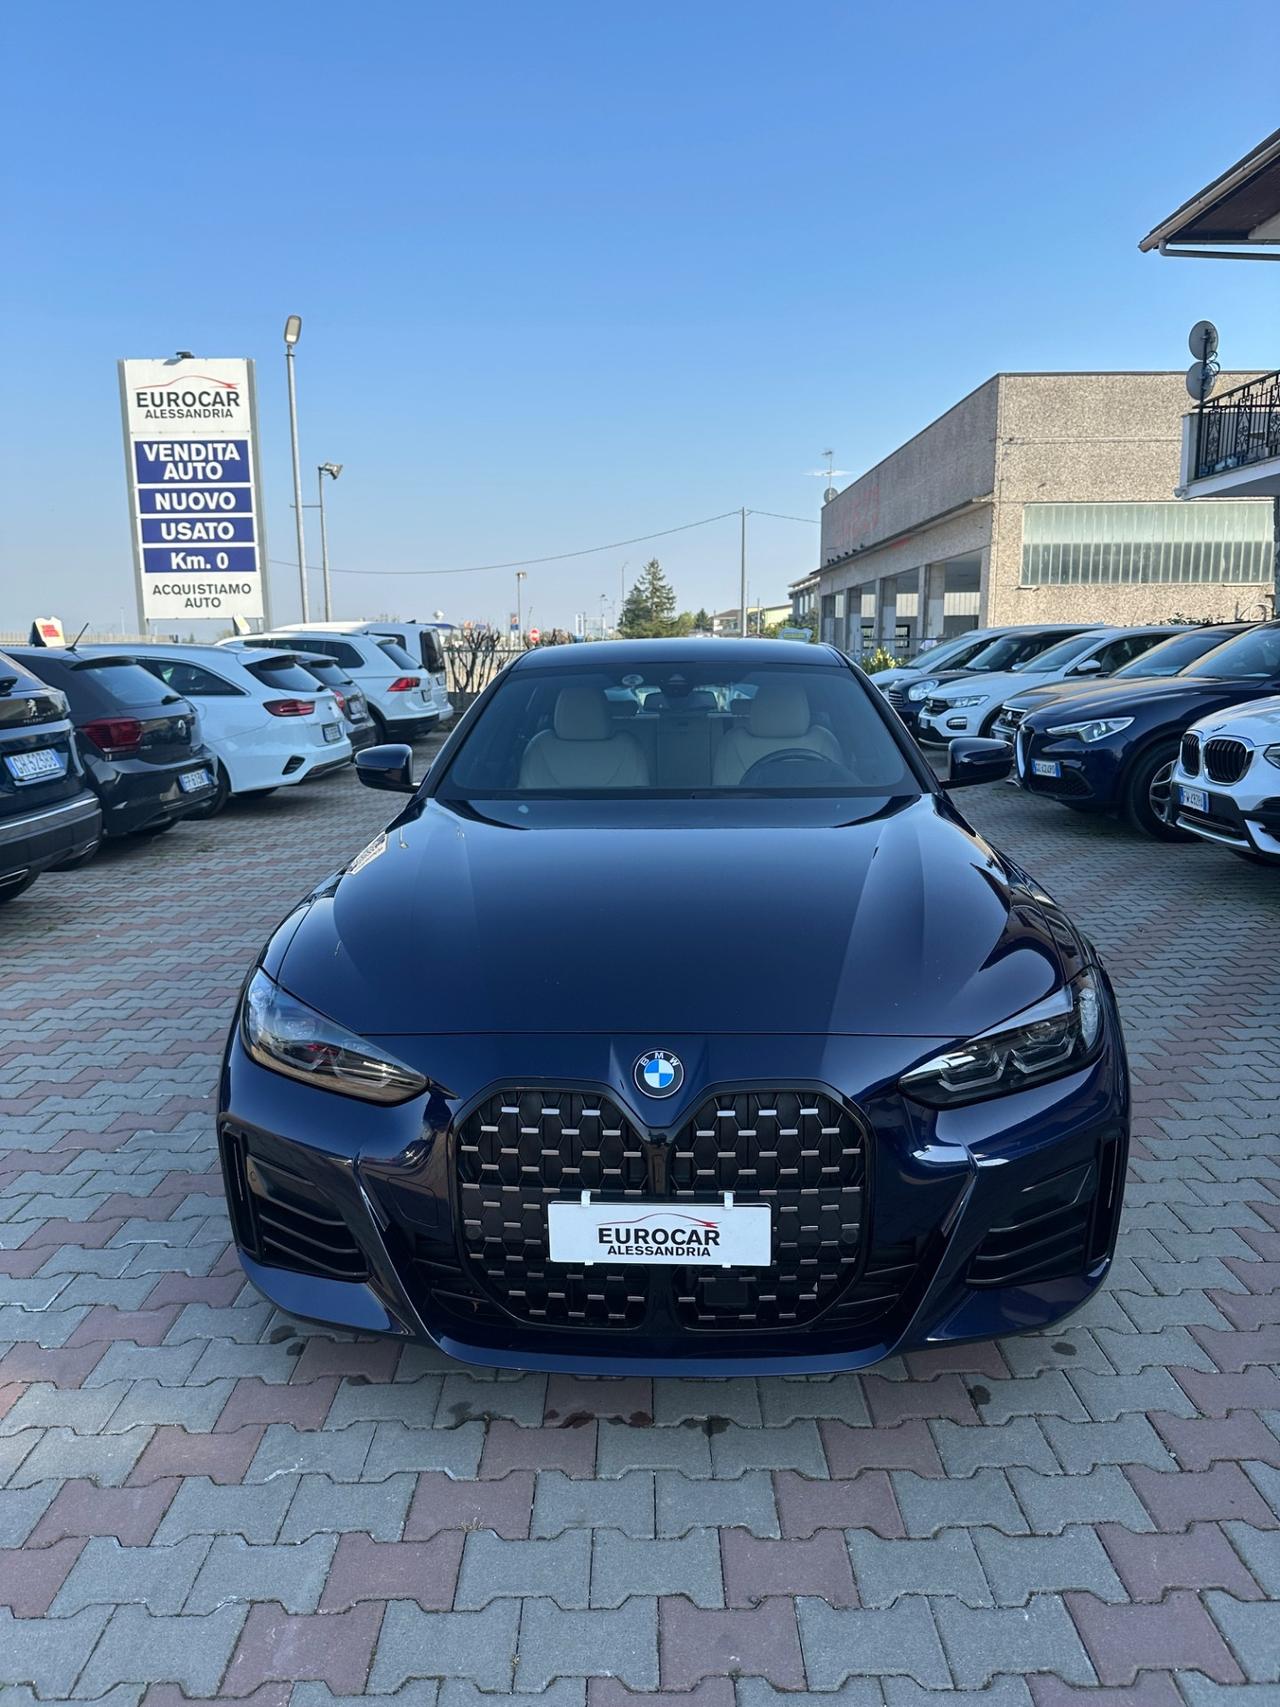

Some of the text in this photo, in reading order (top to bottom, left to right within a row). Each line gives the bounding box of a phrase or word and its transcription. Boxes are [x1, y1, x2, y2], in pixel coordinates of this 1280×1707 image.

[136, 391, 240, 408] EUROCAR
[145, 408, 234, 419] ALESSANDRIA
[143, 443, 240, 461] VENDITA
[163, 462, 223, 480] AUTO
[154, 492, 236, 510] NUOVO
[160, 521, 234, 540] USATO
[171, 552, 229, 570] Km. 0
[152, 583, 252, 596] ACQUISTIAMO
[184, 597, 221, 608] AUTO
[640, 1052, 680, 1067] BMW
[598, 1227, 720, 1246] EUROCAR
[607, 1245, 711, 1257] ALESSANDRIA
